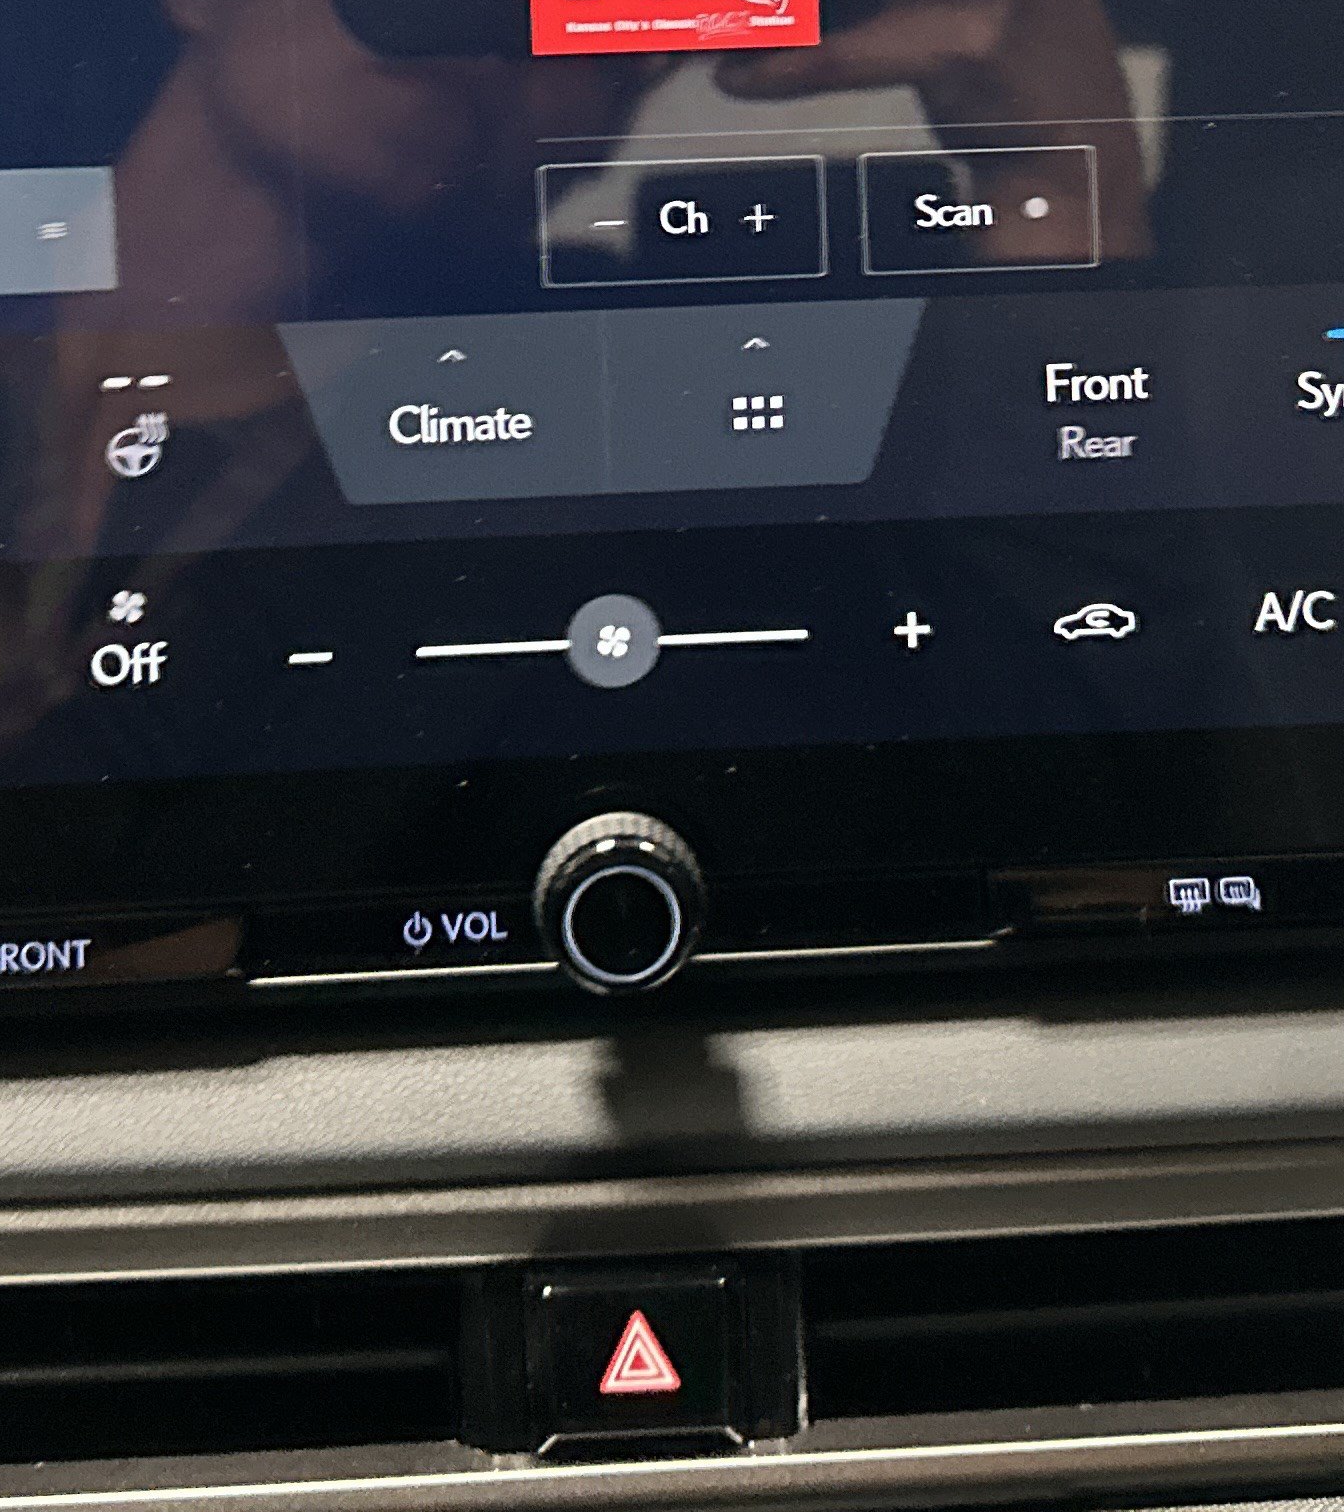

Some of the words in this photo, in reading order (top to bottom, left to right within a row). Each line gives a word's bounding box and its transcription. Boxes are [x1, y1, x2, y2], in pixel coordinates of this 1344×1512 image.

[659, 201, 709, 235] Ch
[914, 195, 994, 229] Scan
[1045, 363, 1150, 403] Front
[388, 402, 533, 444] Climate
[1059, 426, 1137, 460] Rear
[1254, 590, 1337, 632] A/C
[90, 642, 168, 686] Off
[441, 912, 508, 944] VOL
